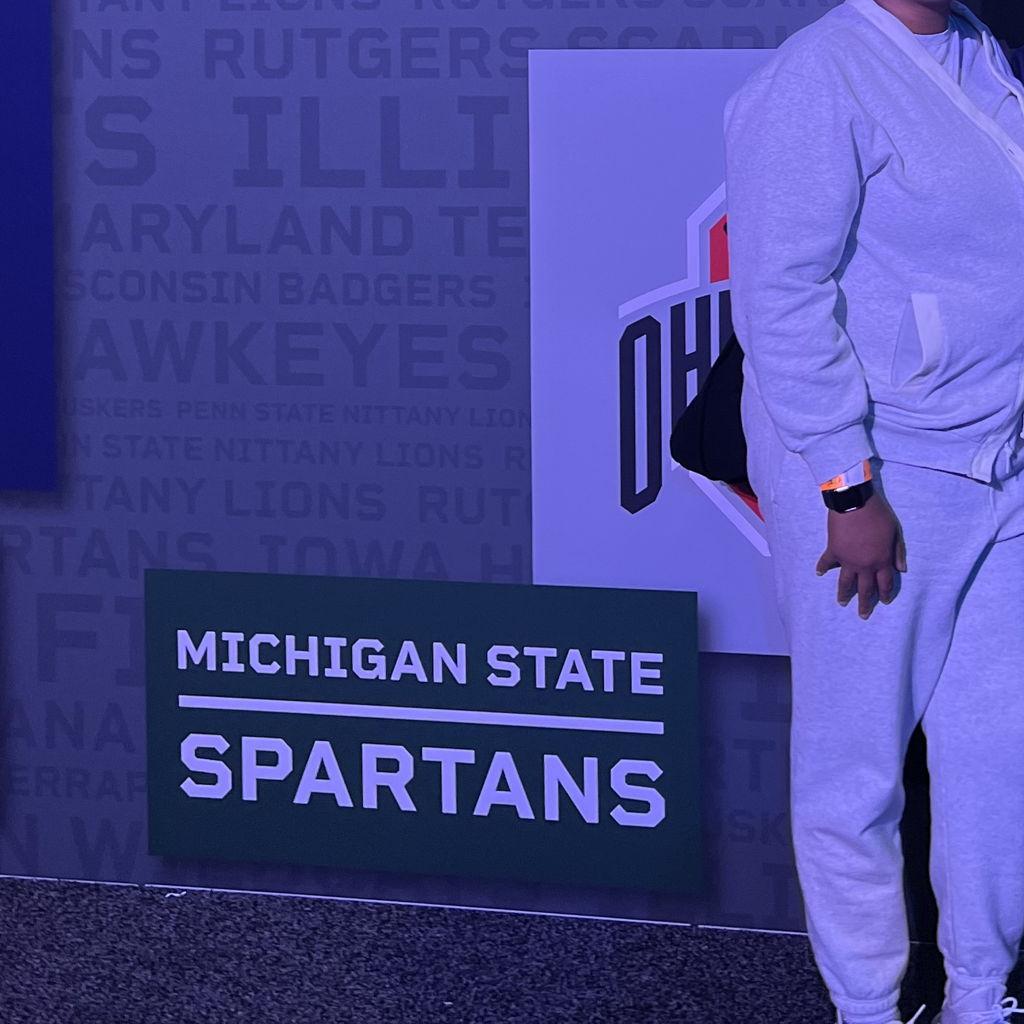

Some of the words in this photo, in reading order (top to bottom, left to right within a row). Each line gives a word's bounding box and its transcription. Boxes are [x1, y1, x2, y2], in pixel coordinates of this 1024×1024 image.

[278, 272, 498, 308] BADGERS
[176, 399, 247, 421] PENN
[255, 402, 334, 424] STATE
[344, 404, 458, 427] NITTANY
[102, 433, 203, 461] STATE
[214, 437, 364, 467] NITTANY
[376, 442, 484, 471] LIONS
[225, 479, 387, 522] LIONS
[177, 629, 467, 685] MICHIGAN
[486, 643, 665, 697] STATE
[179, 732, 667, 829] SPARTANS
